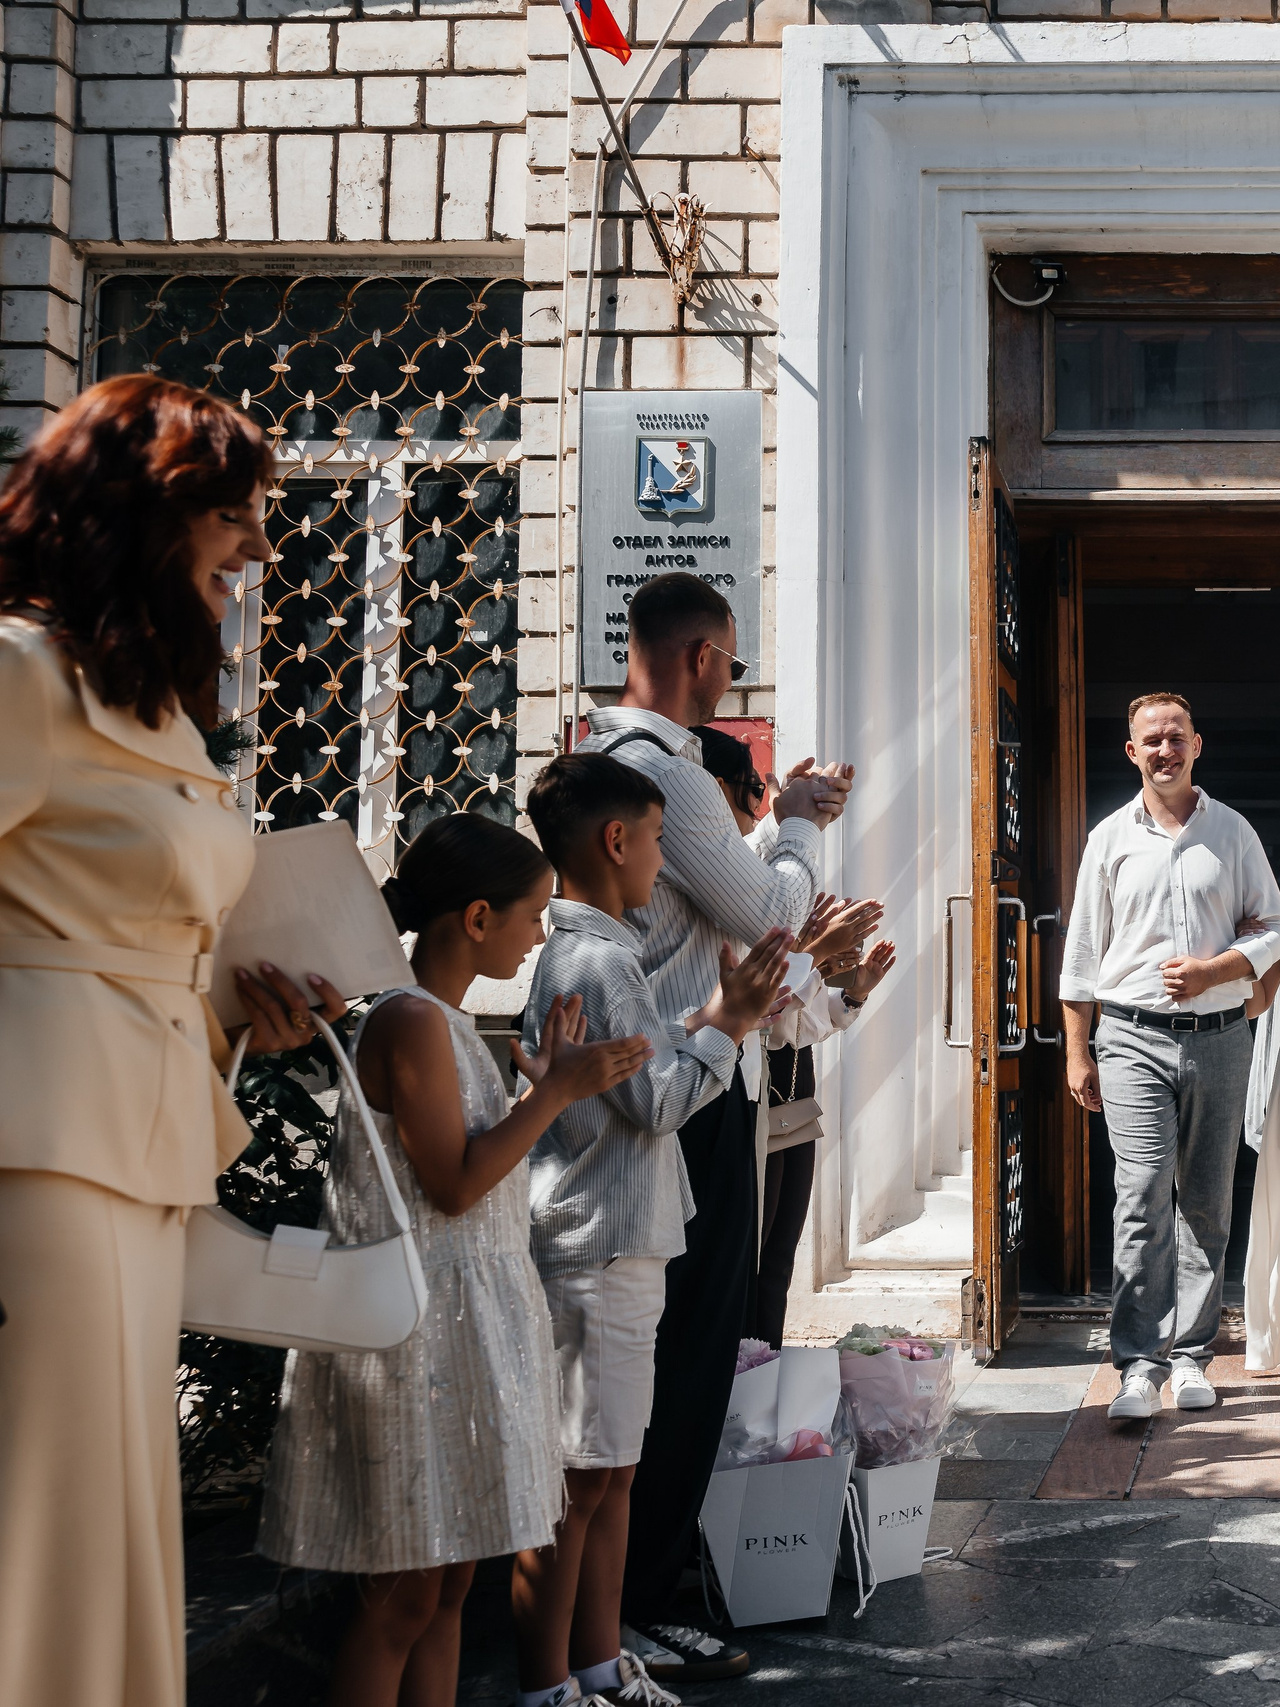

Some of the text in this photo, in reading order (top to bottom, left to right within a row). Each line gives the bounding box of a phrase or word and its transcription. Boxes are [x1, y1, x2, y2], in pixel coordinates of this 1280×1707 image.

[612, 535, 731, 549] ОТДЕЛ ЗАПИСИ
[645, 554, 697, 567] АКТОВ
[877, 1504, 923, 1527] PINK
[745, 1533, 808, 1551] PINK
[757, 1547, 797, 1556] FLOWER
